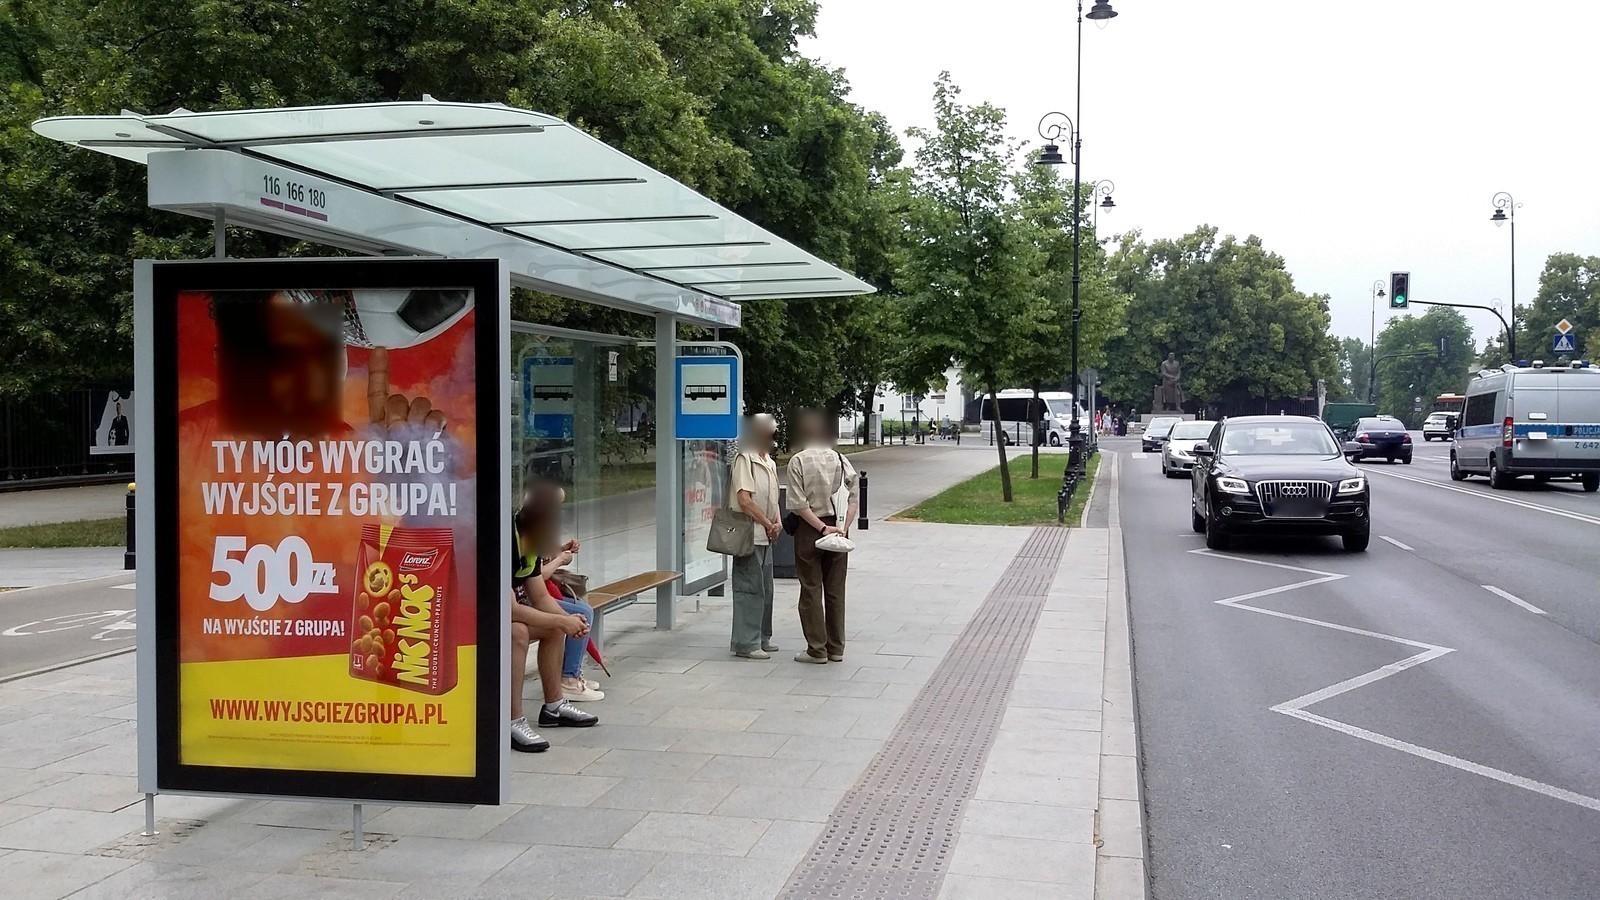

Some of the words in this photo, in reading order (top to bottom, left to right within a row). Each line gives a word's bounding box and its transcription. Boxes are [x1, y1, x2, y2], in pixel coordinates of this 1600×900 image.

[263, 174, 281, 196] 116
[286, 181, 305, 203] 166
[308, 188, 326, 209] 180
[211, 440, 246, 474] TY
[252, 435, 313, 474] MÓC
[319, 431, 446, 475] WYGRAĆ
[202, 474, 321, 516] WYJŚCIE
[327, 482, 344, 516] Z
[349, 482, 457, 517] GRUPA!
[404, 555, 431, 565] Lorenz
[203, 618, 222, 635] NA
[224, 615, 282, 636] WYJŚCIE
[284, 620, 293, 636] Z
[295, 620, 345, 637] GRUPA!
[210, 699, 448, 725] WWW.WYJSCIEZGRUPA.PL
